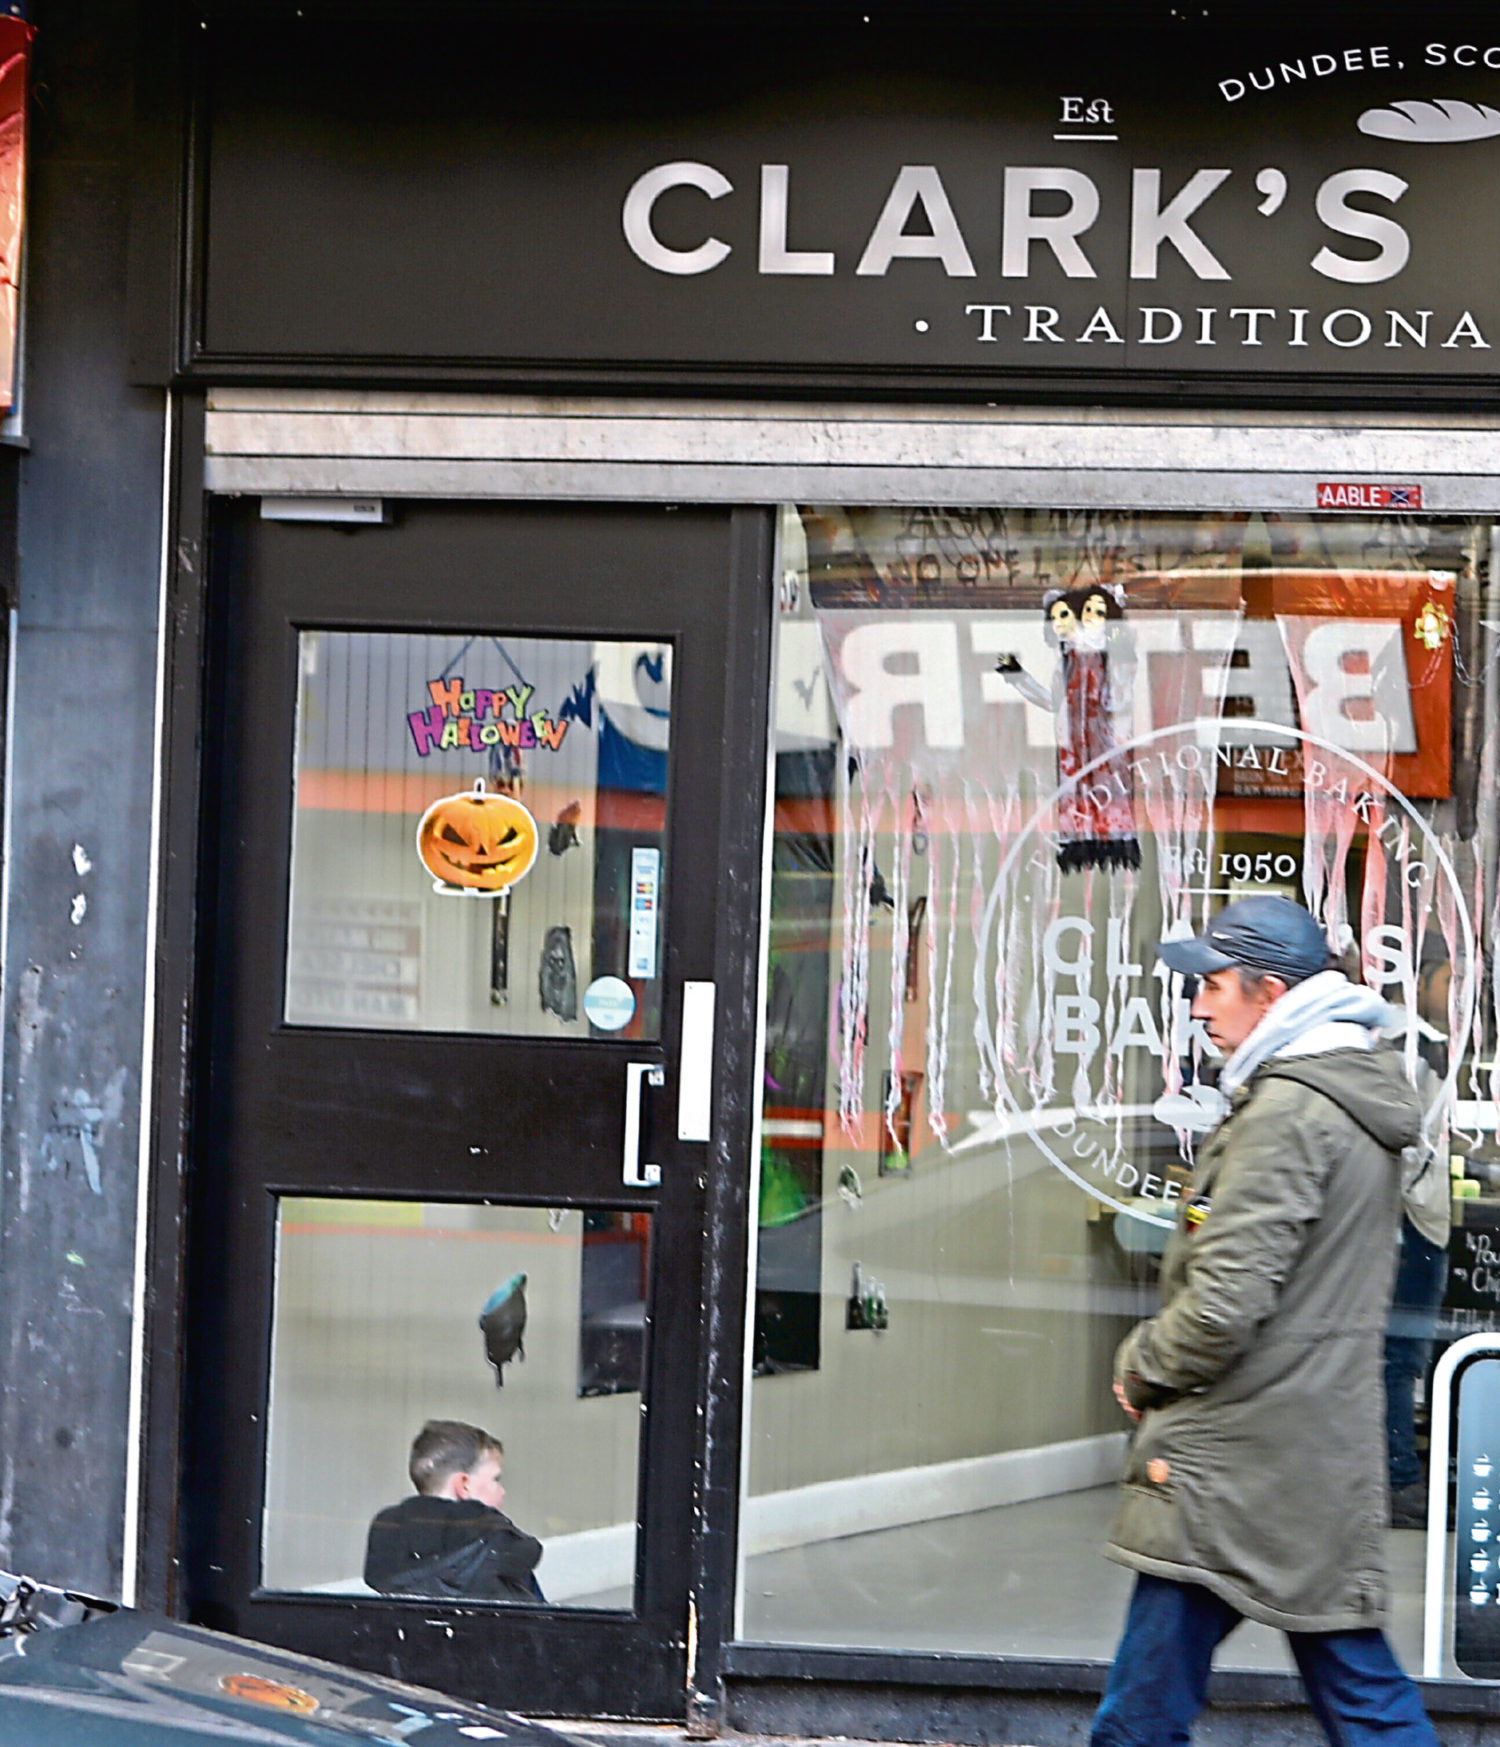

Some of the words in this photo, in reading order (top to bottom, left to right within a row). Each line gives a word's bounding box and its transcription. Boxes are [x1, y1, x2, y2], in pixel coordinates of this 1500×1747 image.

[1218, 45, 1406, 103] DUNDEE,
[1059, 96, 1115, 126] Est
[621, 160, 1411, 285] CLARK'S
[1321, 485, 1382, 507] AABLE
[407, 704, 569, 757] HALLOWEEN
[1303, 759, 1434, 890] BAKING
[1217, 852, 1297, 883] 1950
